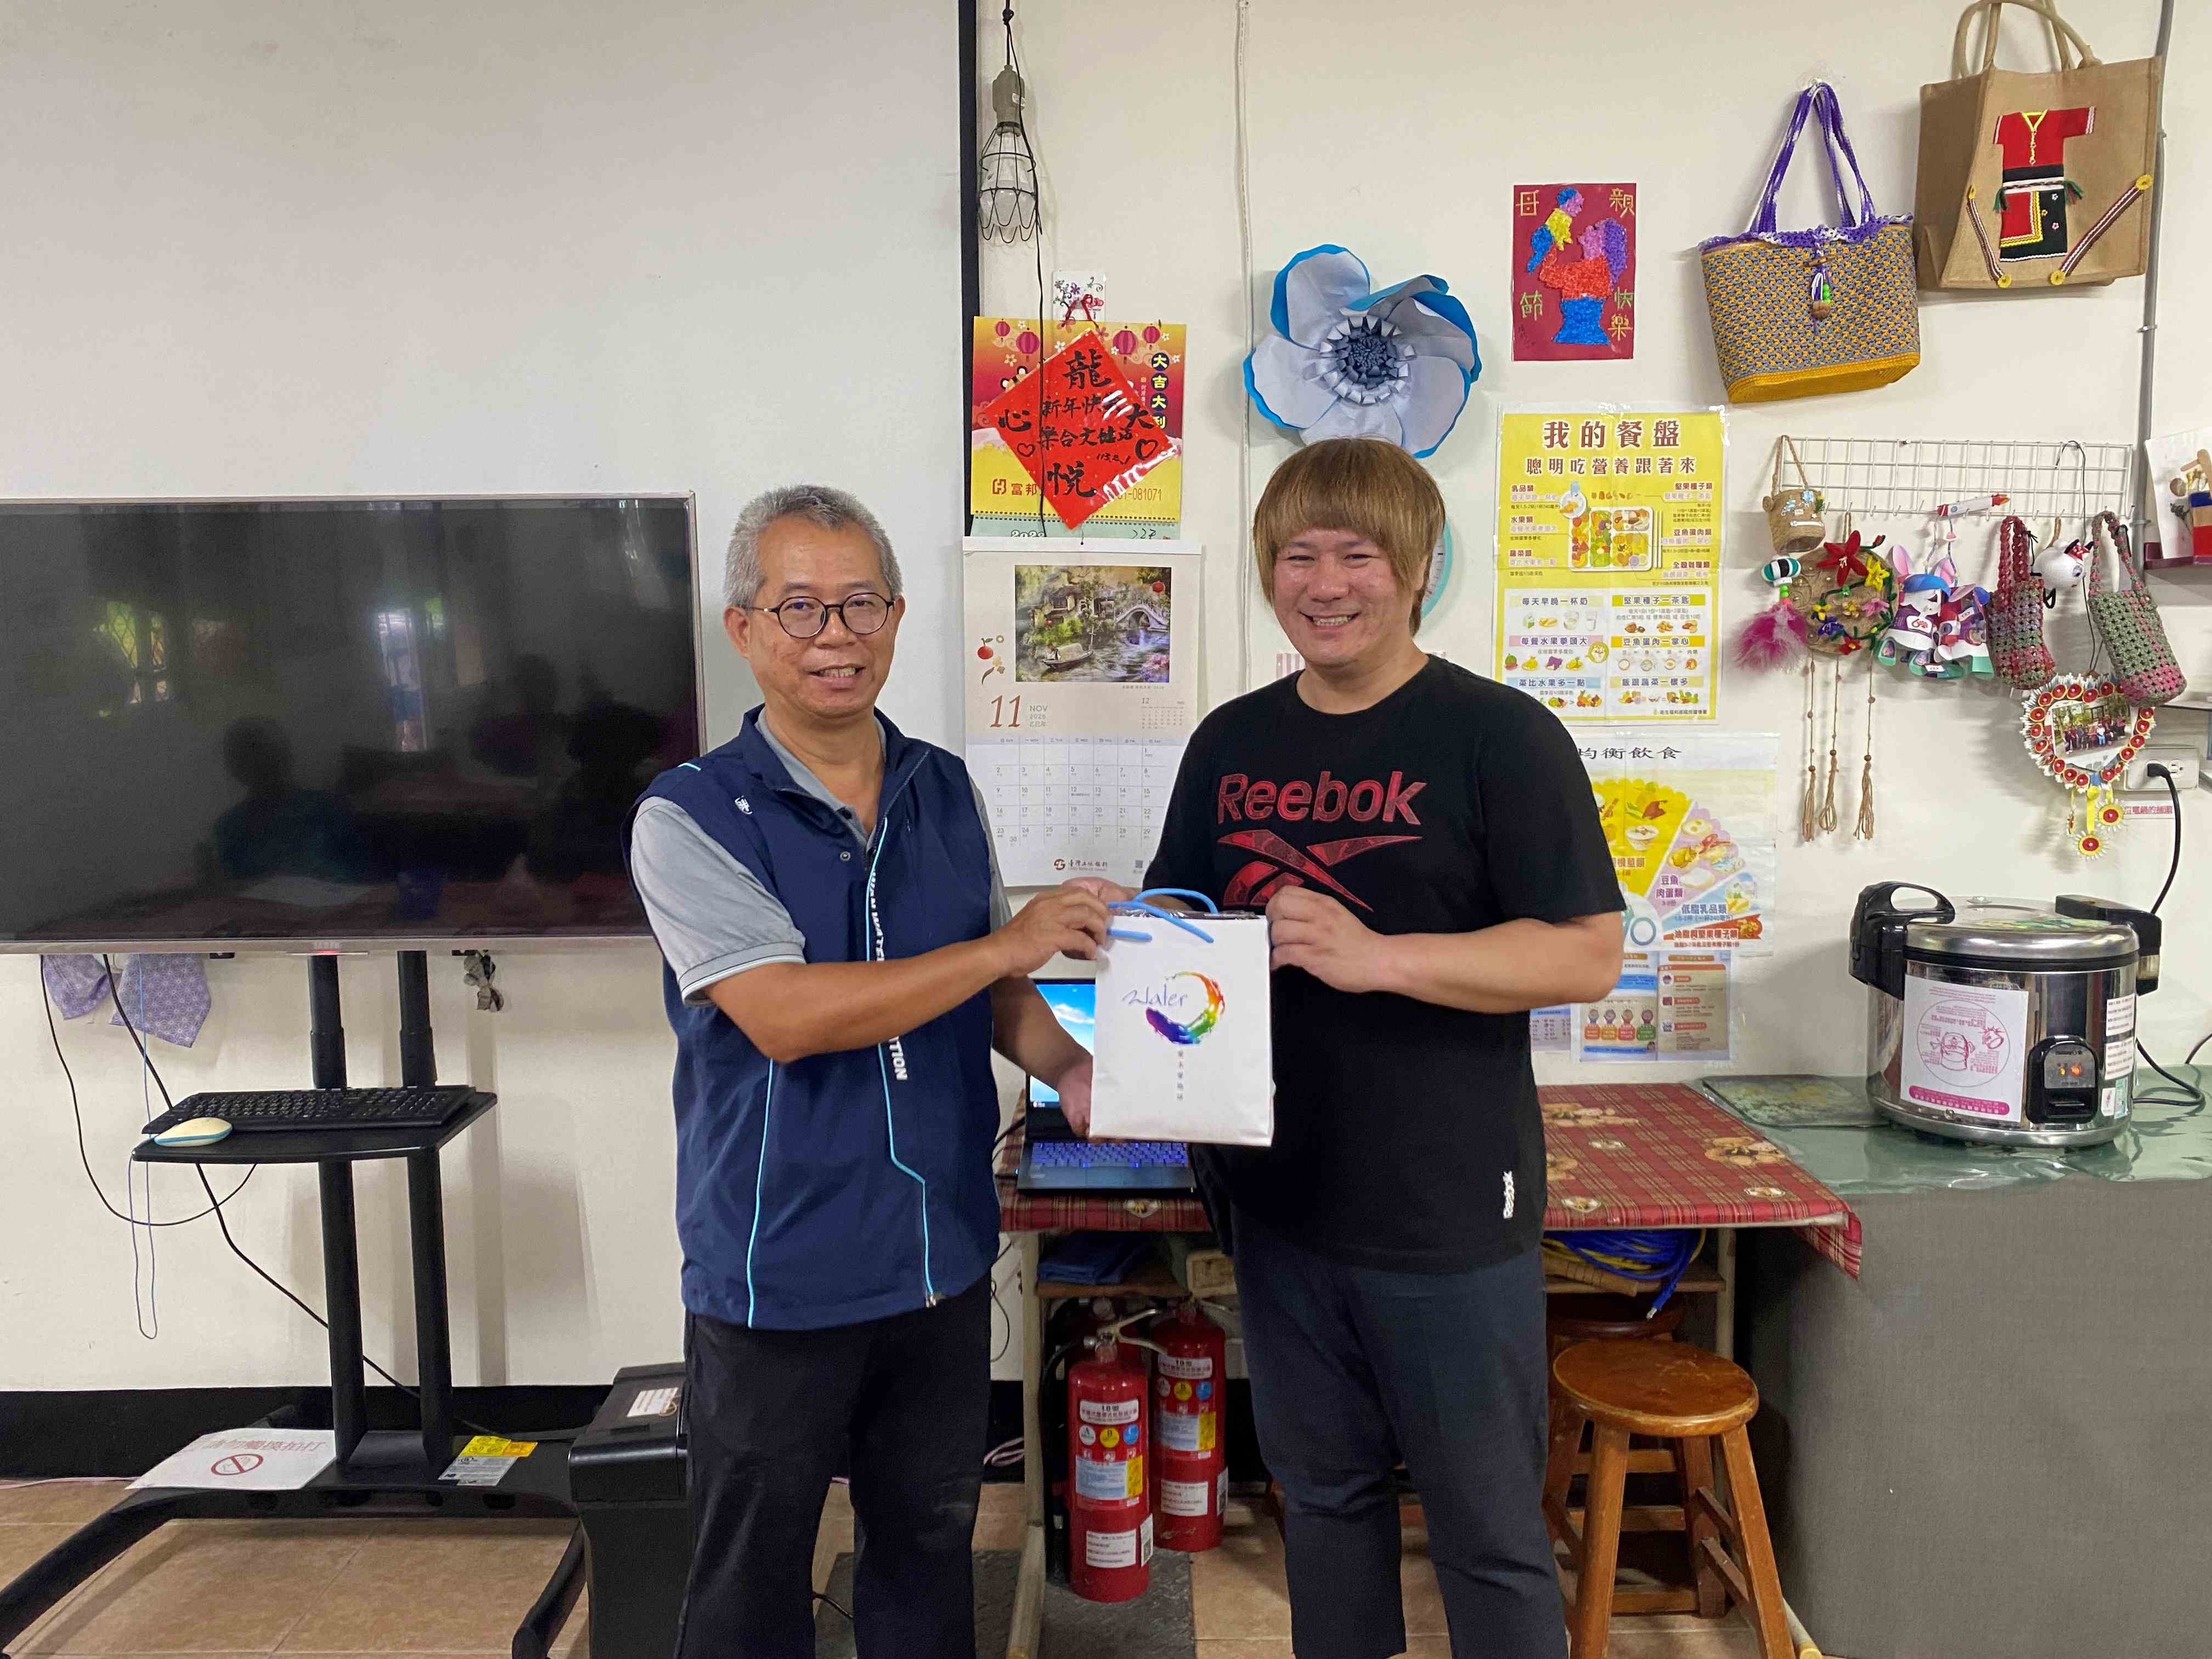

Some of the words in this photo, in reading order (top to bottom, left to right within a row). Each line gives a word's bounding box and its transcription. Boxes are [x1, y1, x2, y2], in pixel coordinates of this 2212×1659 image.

[1063, 349, 1111, 390] 龍
[998, 409, 1032, 432] 心
[1126, 403, 1154, 429] 大
[1544, 420, 1679, 449] 我的餐盤
[1527, 457, 1695, 475] 聰明吃營養跟著來
[1047, 461, 1098, 497] 悅
[1011, 483, 1037, 496] 富邦
[1522, 597, 1588, 606] 每天早晚一杯奶
[1521, 637, 1587, 646] 每餐水果拳頭大
[1623, 637, 1689, 646] 豆魚蛋肉一掌心
[1519, 679, 1585, 687] 菜比水果多一點
[1622, 678, 1689, 686] 飯跟蔬菜一樣多
[990, 695, 1021, 727] 11
[1217, 771, 1426, 825] Reebok
[1661, 876, 1678, 885] 豆魚
[1656, 888, 1683, 898] 肉蛋類
